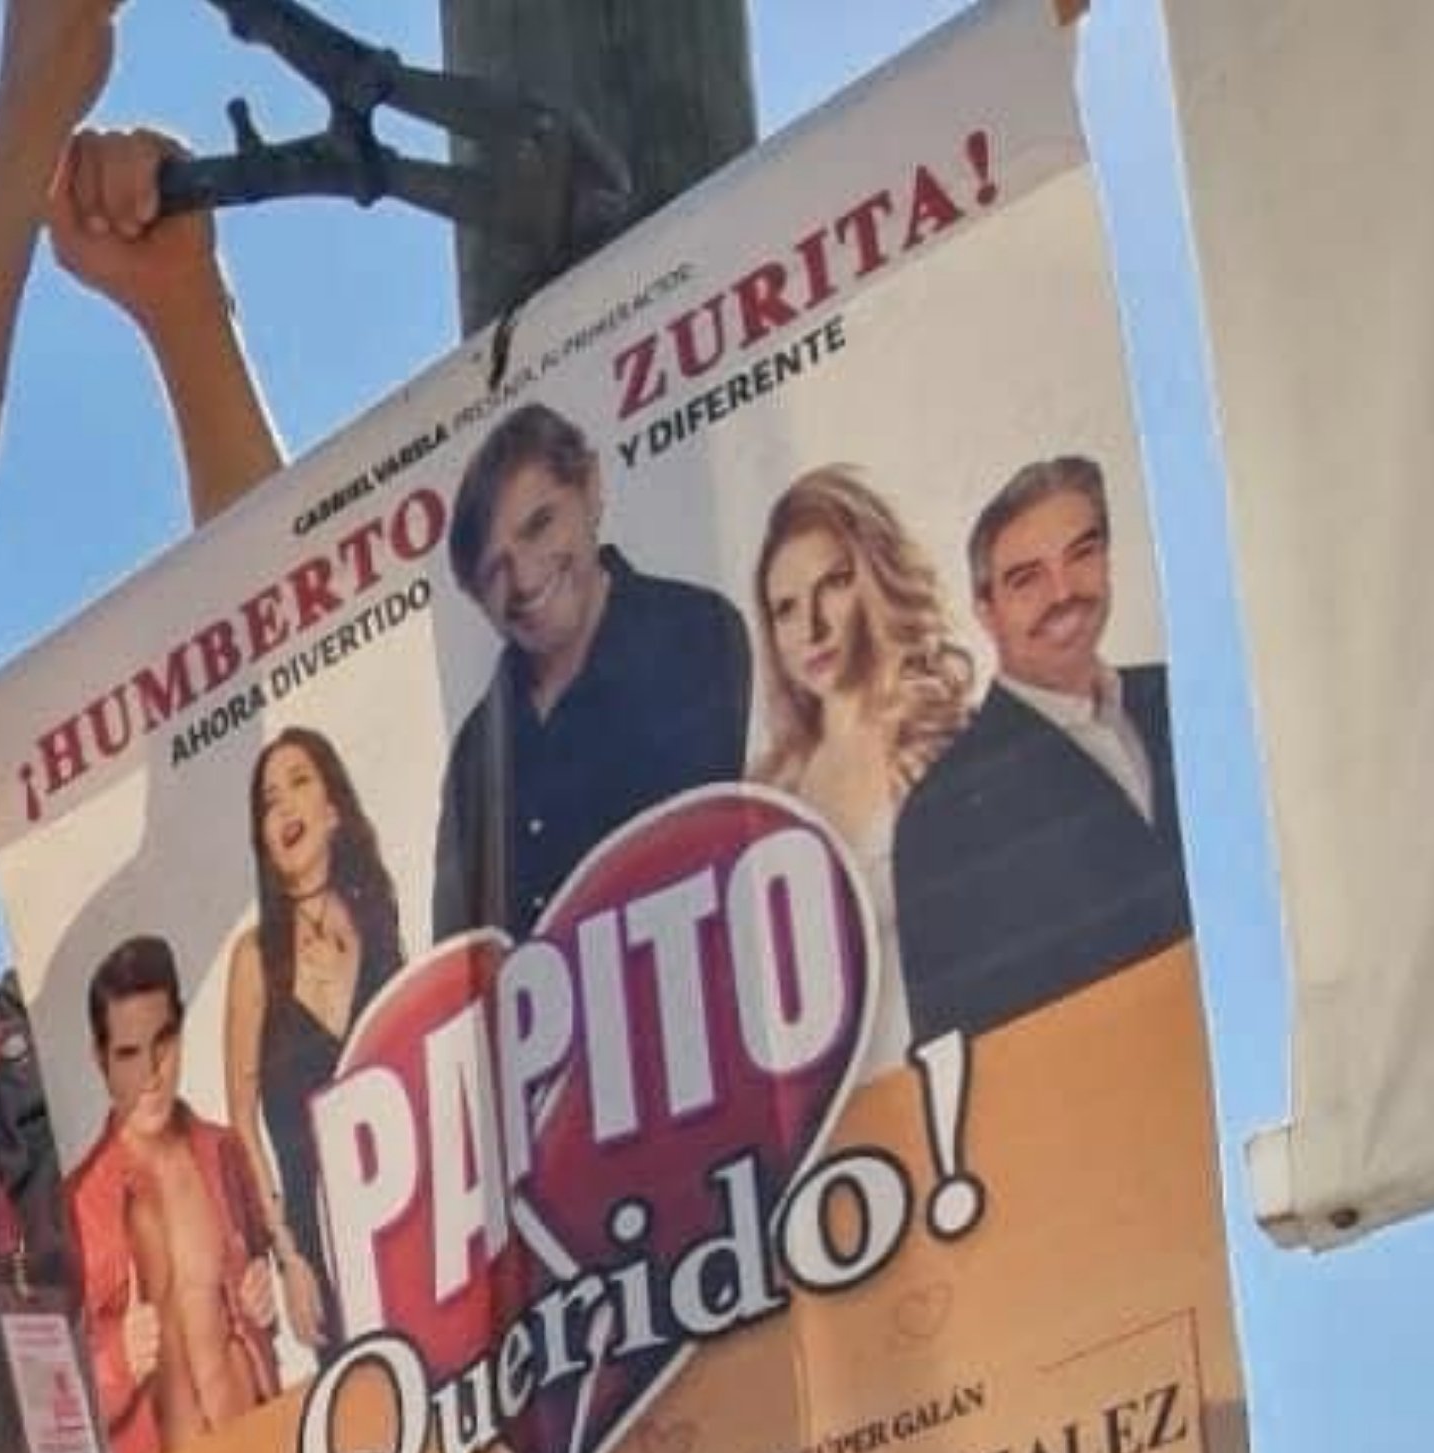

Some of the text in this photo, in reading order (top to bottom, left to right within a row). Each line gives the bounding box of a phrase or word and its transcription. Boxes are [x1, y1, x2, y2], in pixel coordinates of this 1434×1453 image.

[17, 130, 998, 822] ¡HUMBERTO ZURITA!
[170, 315, 847, 767] AHORA DIVERTIDO Y DIFERENTE
[310, 826, 848, 1341] PAPITO
